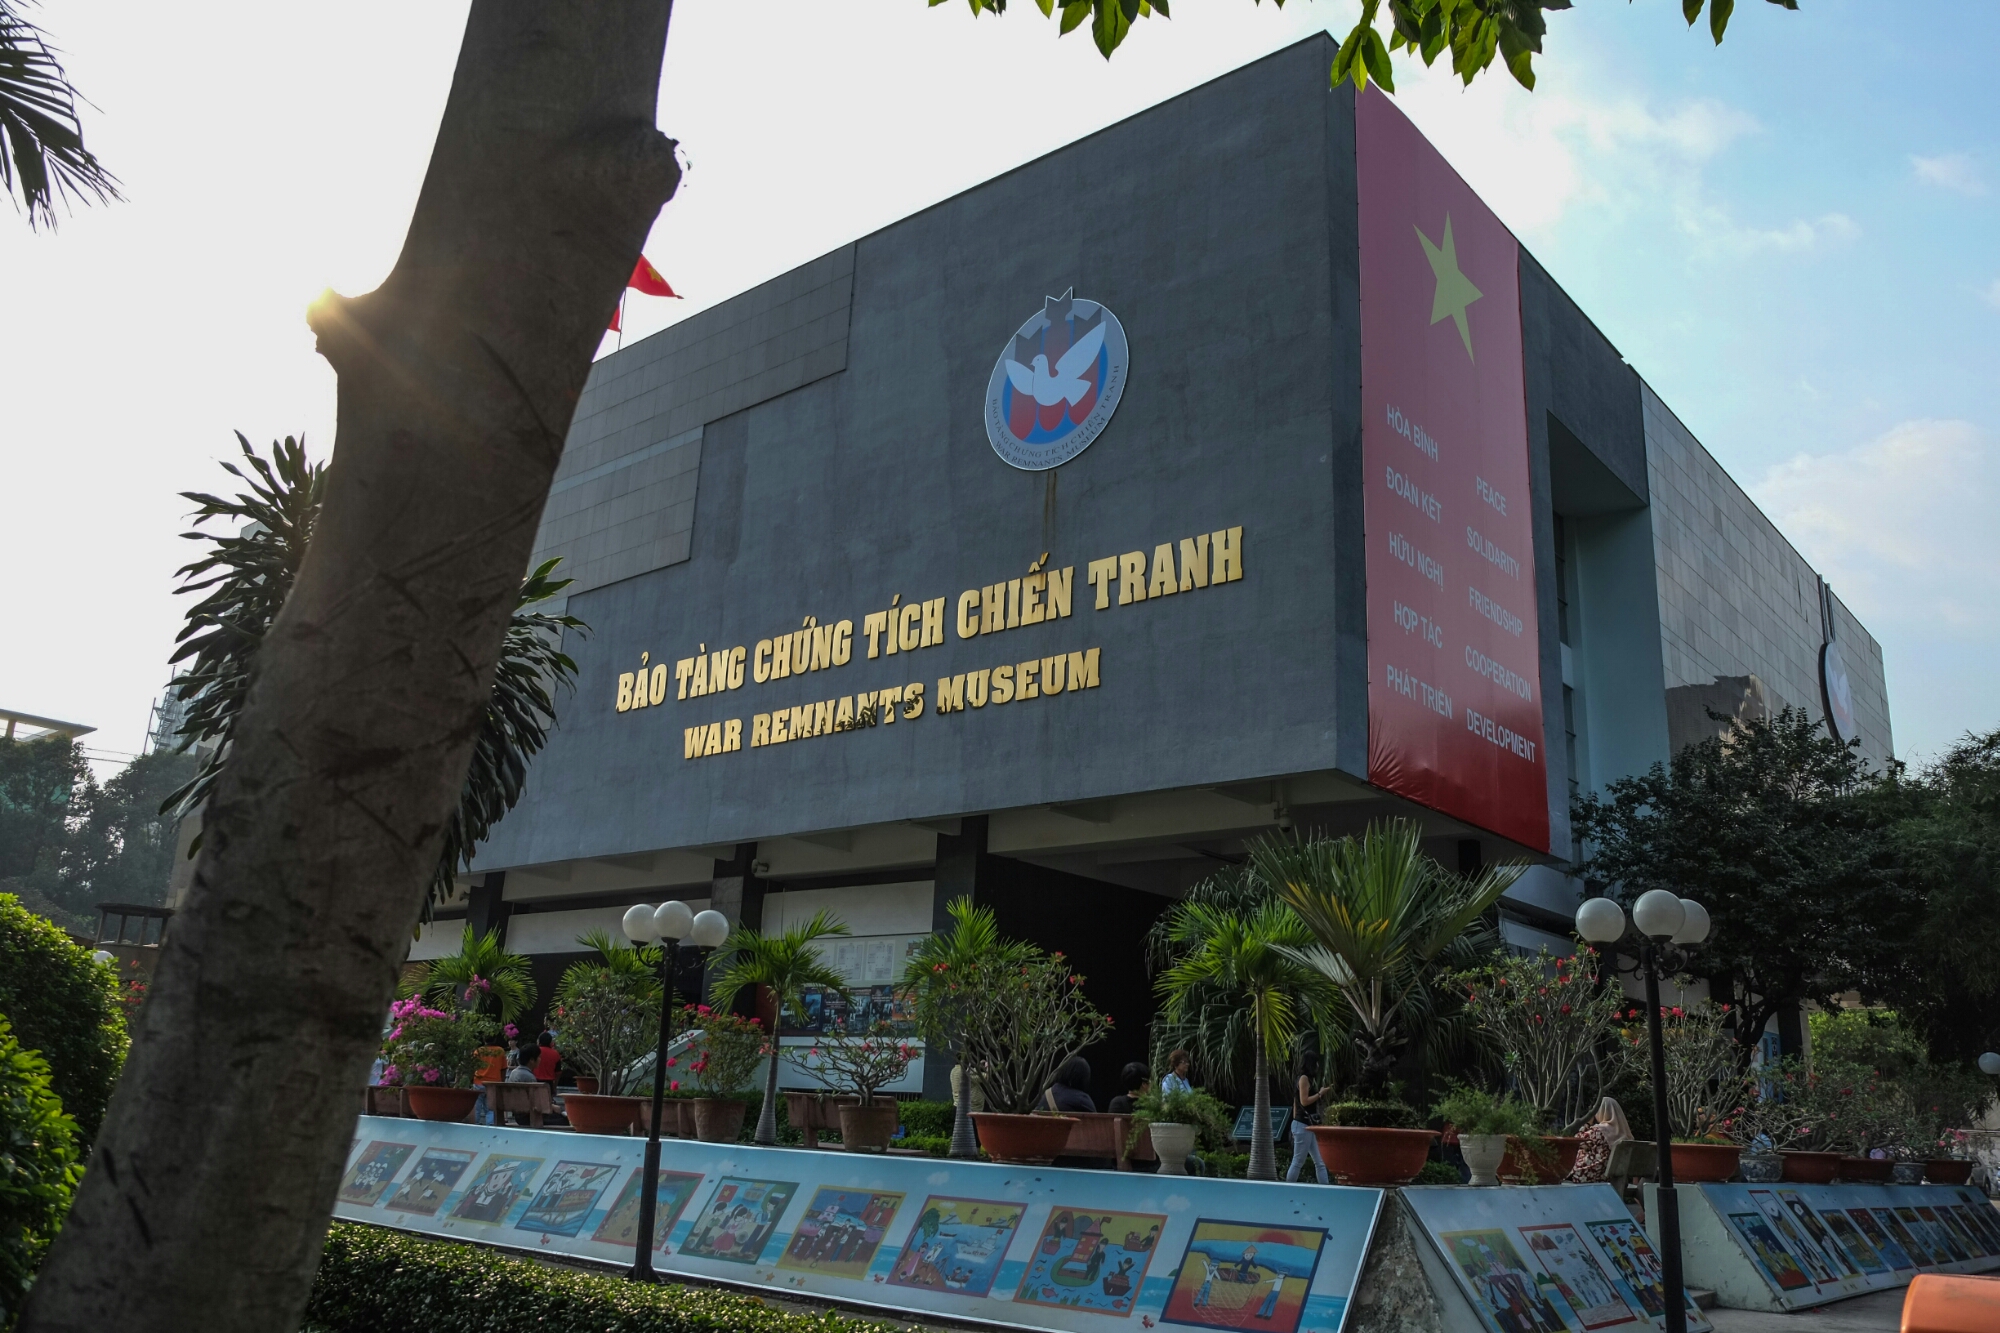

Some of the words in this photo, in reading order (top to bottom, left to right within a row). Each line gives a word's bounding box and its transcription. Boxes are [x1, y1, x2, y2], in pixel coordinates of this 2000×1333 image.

[1100, 365, 1119, 410] TRANH
[995, 440, 1011, 458] WAR
[1011, 454, 1063, 467] REMNANTS
[1066, 416, 1107, 456] MUSEUM
[1387, 403, 1411, 441] HÒA
[1413, 424, 1439, 463] BÌNH
[1386, 465, 1419, 509] ĐOÀN
[1476, 475, 1507, 517] PEACE
[1389, 531, 1415, 568] HỮU
[1417, 550, 1444, 592] NGHỊ
[1466, 525, 1520, 581] SOLIDARITY
[615, 651, 668, 714] BẢO
[675, 643, 747, 701] TÀNG
[753, 615, 854, 685] CHỨNG
[863, 594, 946, 660] TÍCH
[957, 552, 1075, 639] CHIẾN
[1088, 526, 1243, 610] TRANH
[1394, 600, 1419, 635] HỢP
[1421, 616, 1443, 649] TÁC
[1469, 586, 1523, 638] FRIENDSHIP
[1386, 664, 1418, 701] PHÁT
[1420, 682, 1453, 720] TRIỂN
[1465, 645, 1532, 703] COOPERATION
[684, 718, 743, 760] WAR
[751, 682, 925, 748] REMNANTS
[936, 647, 1101, 715] MUSEUM
[1466, 707, 1536, 763] DEVELOPMENT
